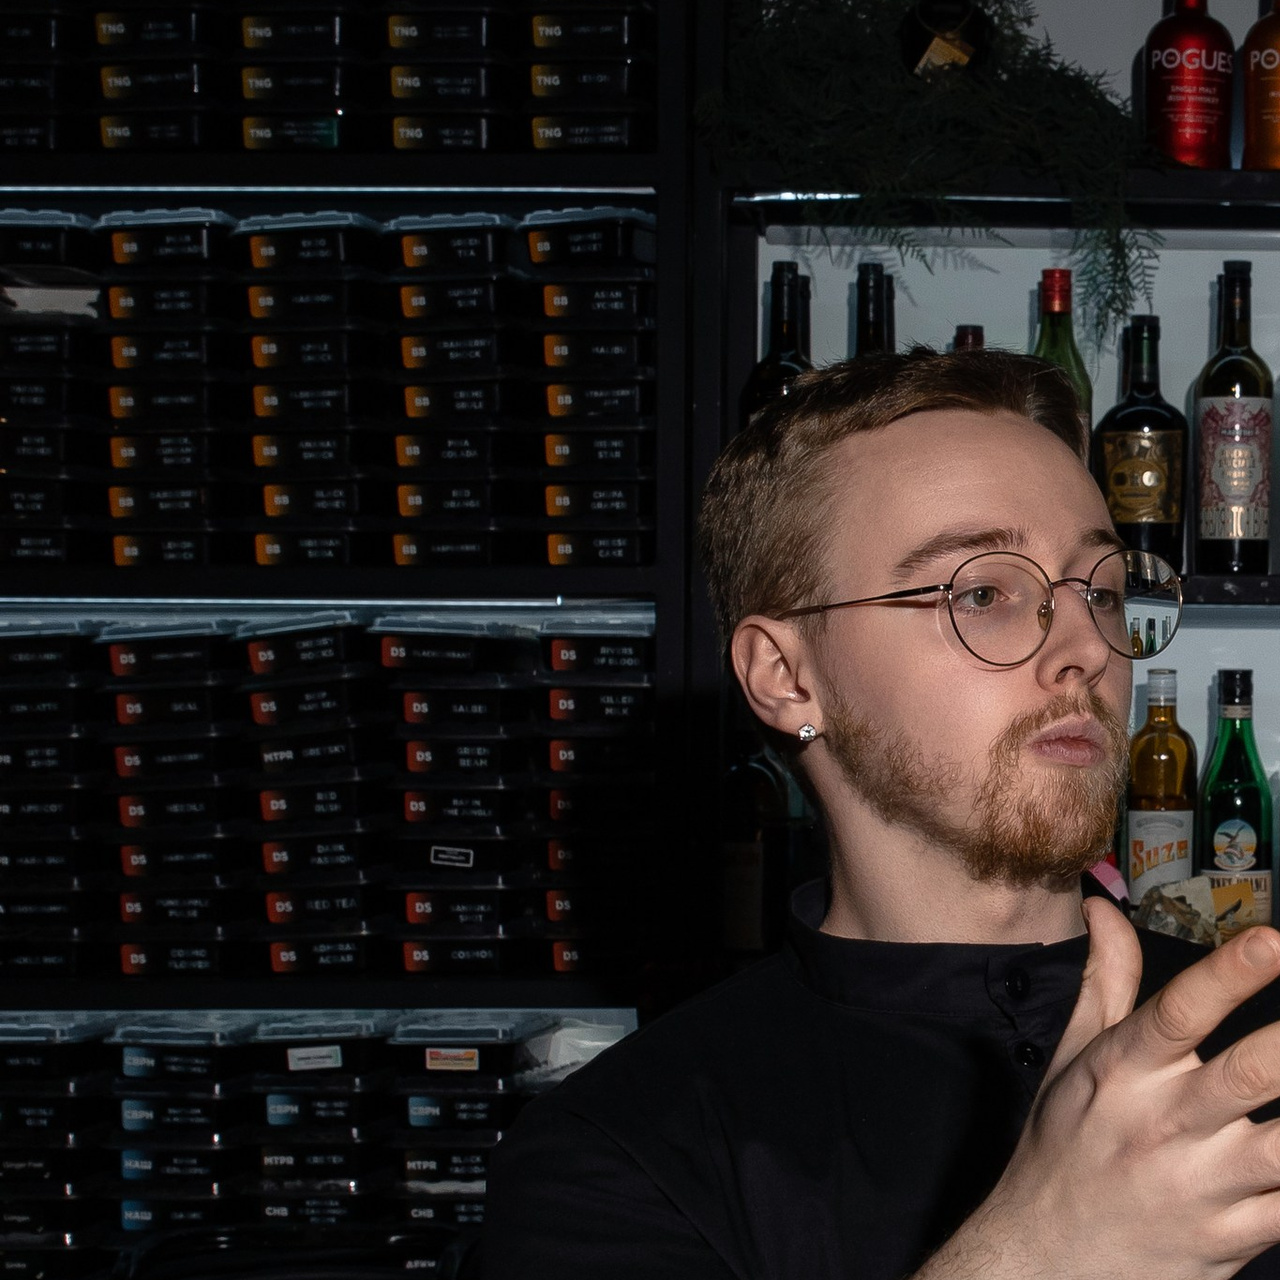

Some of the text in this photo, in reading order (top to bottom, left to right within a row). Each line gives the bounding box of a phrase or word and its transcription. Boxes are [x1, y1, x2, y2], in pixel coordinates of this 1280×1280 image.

[101, 23, 125, 34] TNG
[248, 27, 273, 38] TNG
[394, 27, 418, 37] TNG
[538, 27, 562, 37] TNG
[1151, 47, 1234, 73] POGUES
[107, 77, 132, 88] TNG
[247, 79, 273, 89] TNG
[397, 77, 420, 87] TNG
[536, 76, 560, 86] TNG
[106, 127, 131, 138] TNG
[250, 128, 272, 138] TNG
[399, 128, 423, 138] TNG
[538, 128, 562, 138] TNG
[261, 246, 275, 256] BB
[413, 245, 427, 256] BB
[537, 241, 551, 252] BB
[457, 249, 475, 258] TEA
[259, 296, 273, 307] BB
[411, 296, 426, 306] BB
[553, 295, 568, 306] BB
[261, 343, 277, 354] BB
[411, 347, 426, 358] BB
[554, 345, 569, 356] BB
[263, 396, 278, 406] BB
[415, 397, 430, 407] BB
[557, 394, 572, 405] BB
[263, 446, 277, 457] BB
[405, 445, 420, 456] BB
[555, 445, 570, 455] BB
[274, 495, 289, 505] BB
[408, 495, 423, 505] BB
[555, 496, 570, 506] BB
[266, 544, 281, 554] BB
[402, 544, 417, 554] BB
[558, 544, 573, 554] BB
[258, 650, 275, 661] DS
[391, 647, 406, 657] DS
[561, 650, 576, 660] DS
[120, 654, 136, 664] DS
[126, 703, 143, 714] DS
[260, 701, 277, 712] DS
[412, 702, 429, 713] DS
[559, 699, 575, 710] DS
[124, 755, 141, 766] DS
[263, 750, 294, 762] MTPR
[416, 751, 432, 761] DS
[559, 750, 575, 760] DS
[128, 805, 145, 816] DS
[270, 800, 287, 811] DS
[410, 801, 426, 812] DS
[130, 855, 146, 865] DS
[273, 851, 289, 862] DS
[125, 902, 142, 913] DS
[276, 901, 293, 913] DS
[334, 899, 357, 909] TEA
[415, 902, 432, 913] DS
[556, 900, 571, 910] DS
[130, 953, 146, 964] DS
[280, 951, 297, 961] DS
[413, 950, 430, 961] DS
[563, 950, 579, 961] DS
[264, 1156, 294, 1165] MTPR
[407, 1161, 438, 1171] MTPR
